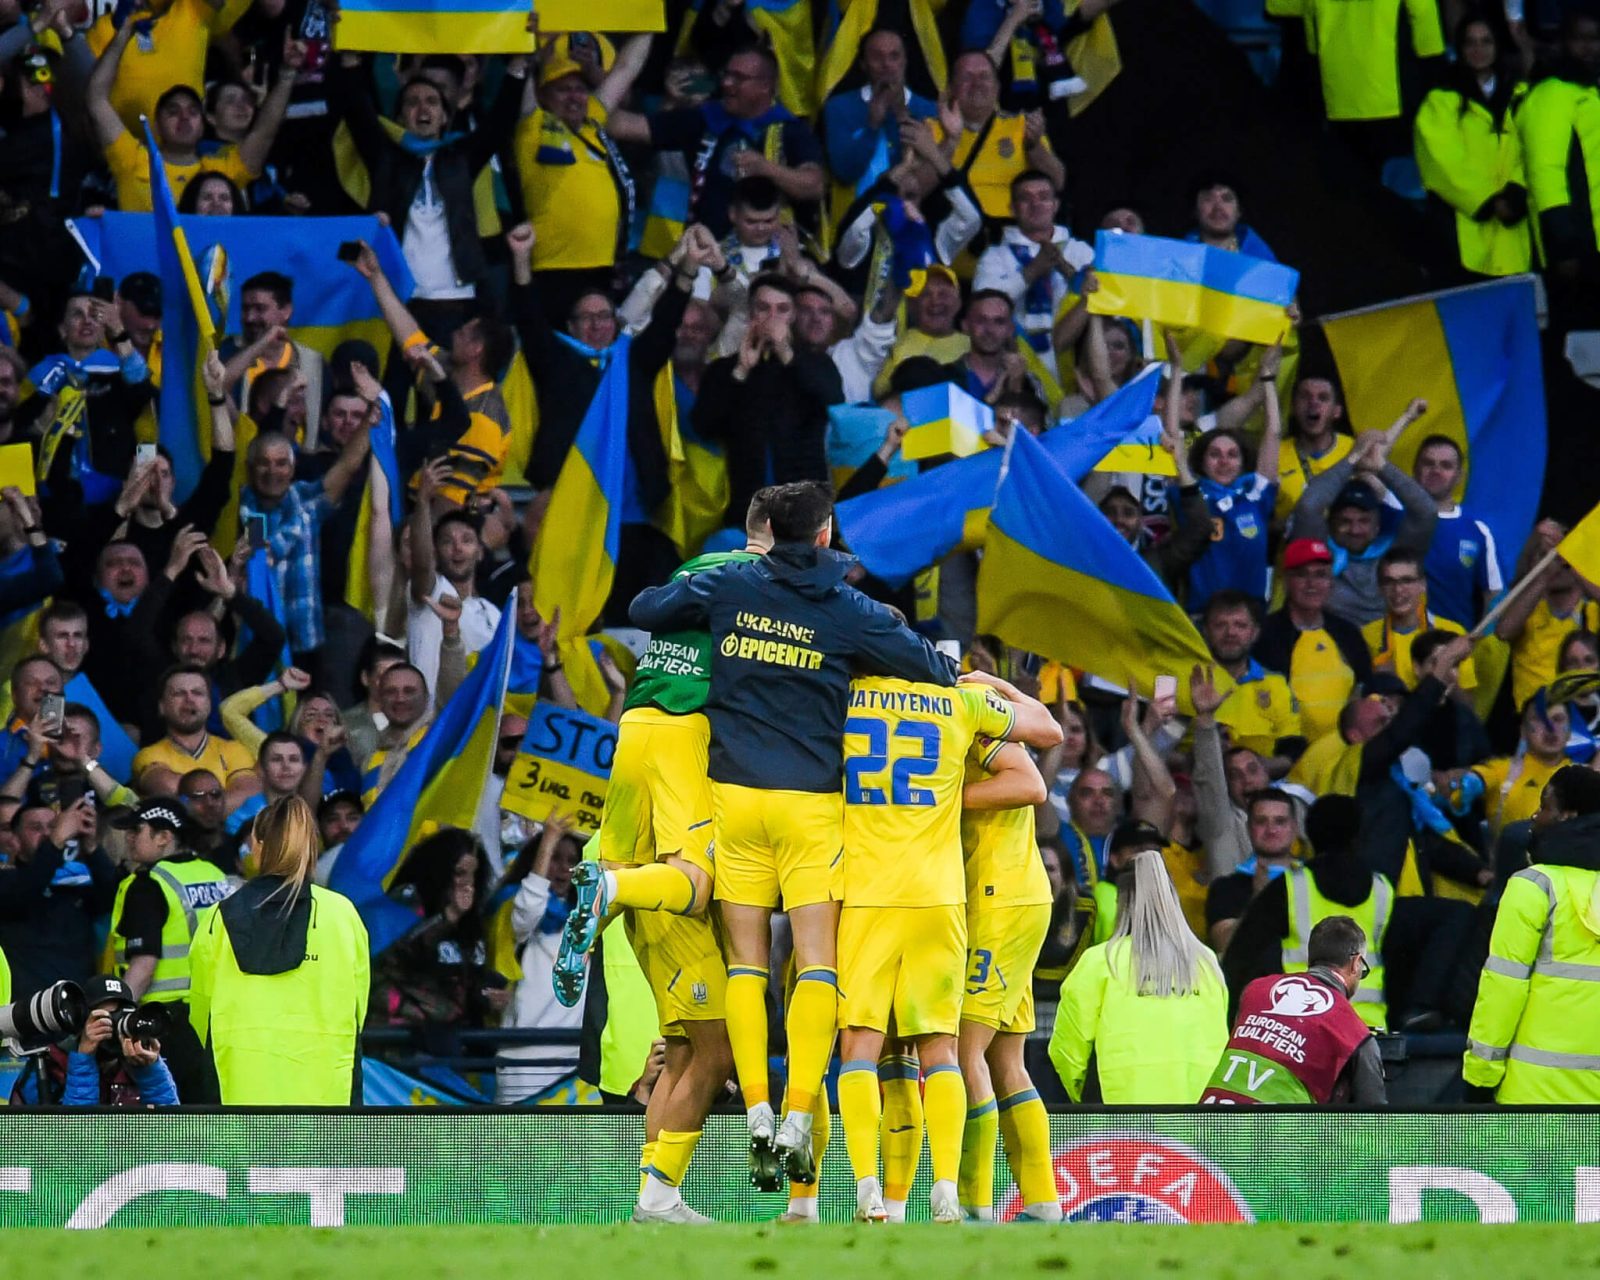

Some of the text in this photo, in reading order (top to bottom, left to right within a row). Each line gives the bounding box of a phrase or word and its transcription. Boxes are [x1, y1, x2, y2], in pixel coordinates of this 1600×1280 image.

[735, 611, 815, 644] UKRAINE
[645, 640, 700, 663] UROPEAN
[738, 636, 823, 670] EPICENTR
[531, 713, 616, 769] STO
[844, 717, 941, 807] 22
[1234, 1025, 1306, 1064] QUALIFIERS
[1245, 1014, 1307, 1047] EUROPEAN
[1223, 1055, 1276, 1092] TV
